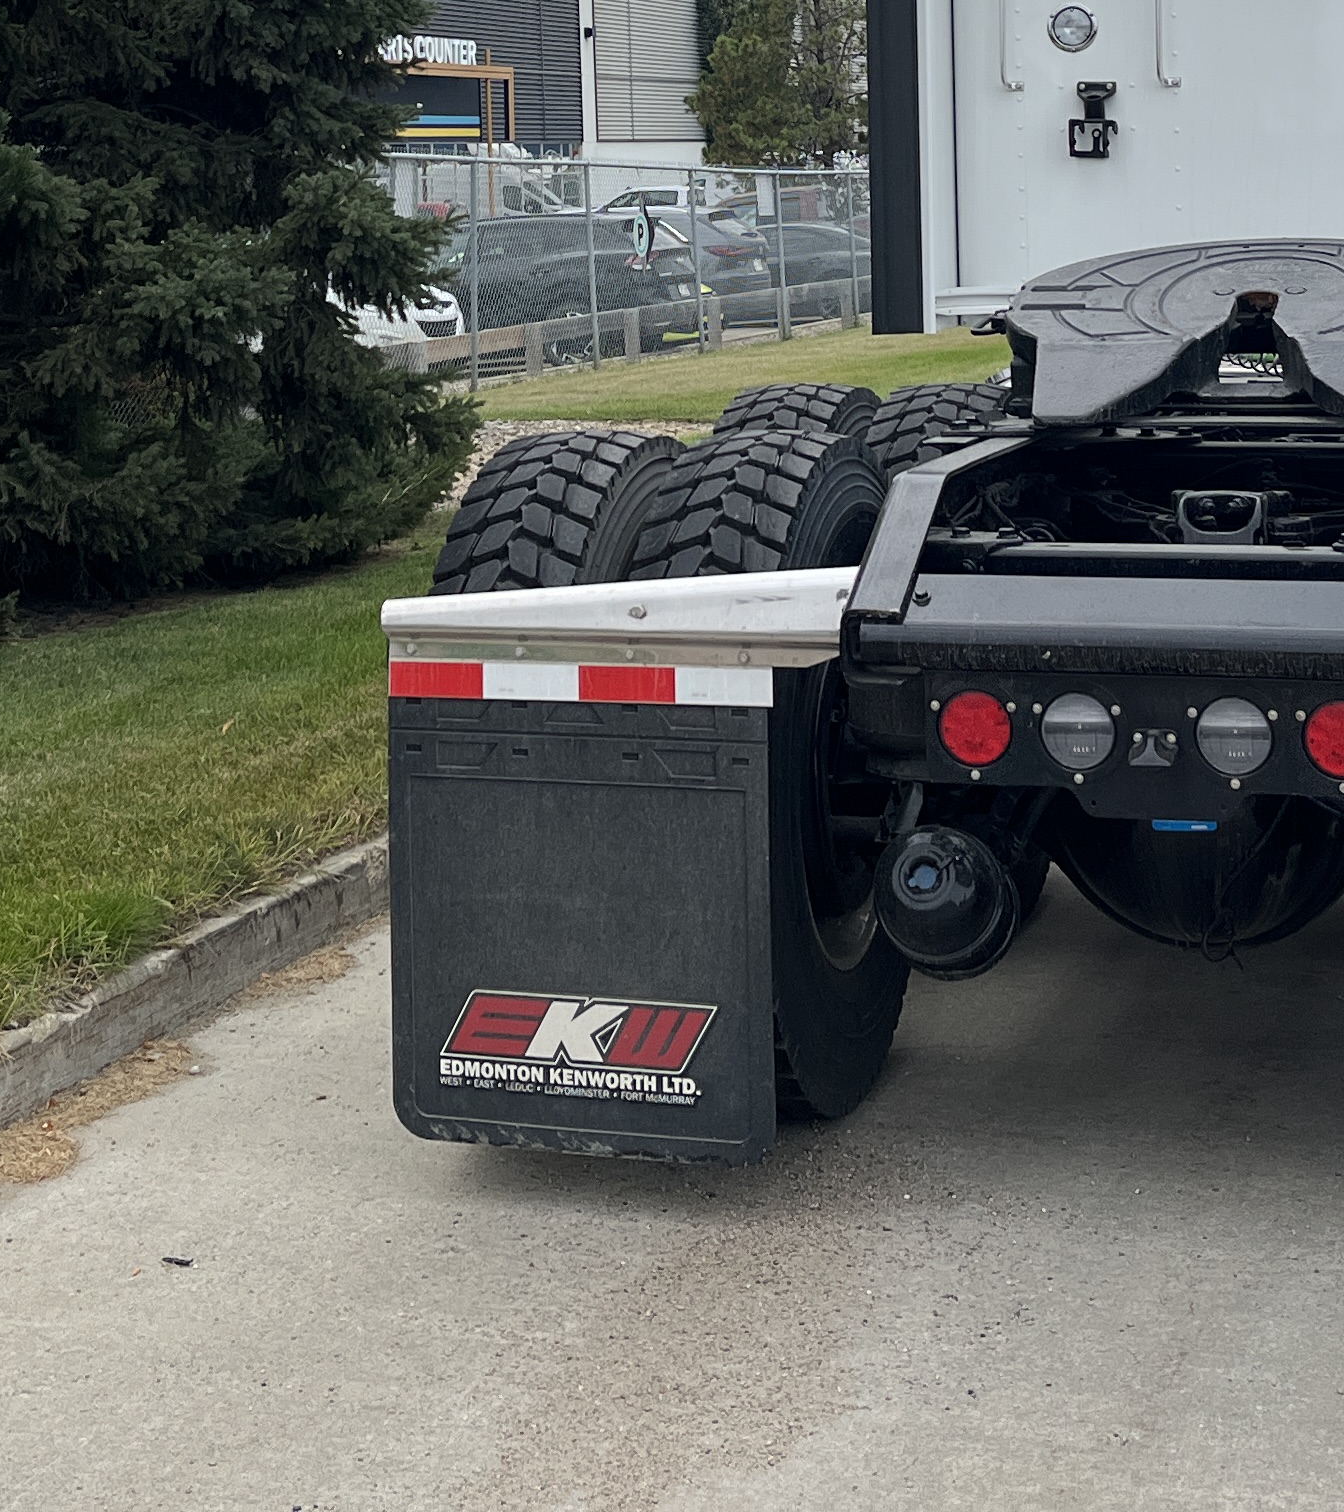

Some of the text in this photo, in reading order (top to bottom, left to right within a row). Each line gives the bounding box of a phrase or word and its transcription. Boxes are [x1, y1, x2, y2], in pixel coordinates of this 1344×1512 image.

[413, 35, 477, 66] COUNTER
[637, 223, 644, 246] P
[449, 994, 708, 1070] EKW
[439, 1058, 702, 1096] EDMONTON KENWORTH LTD.
[439, 1076, 463, 1086] WEST
[473, 1078, 495, 1089] EAST
[620, 1091, 643, 1102] FORT
